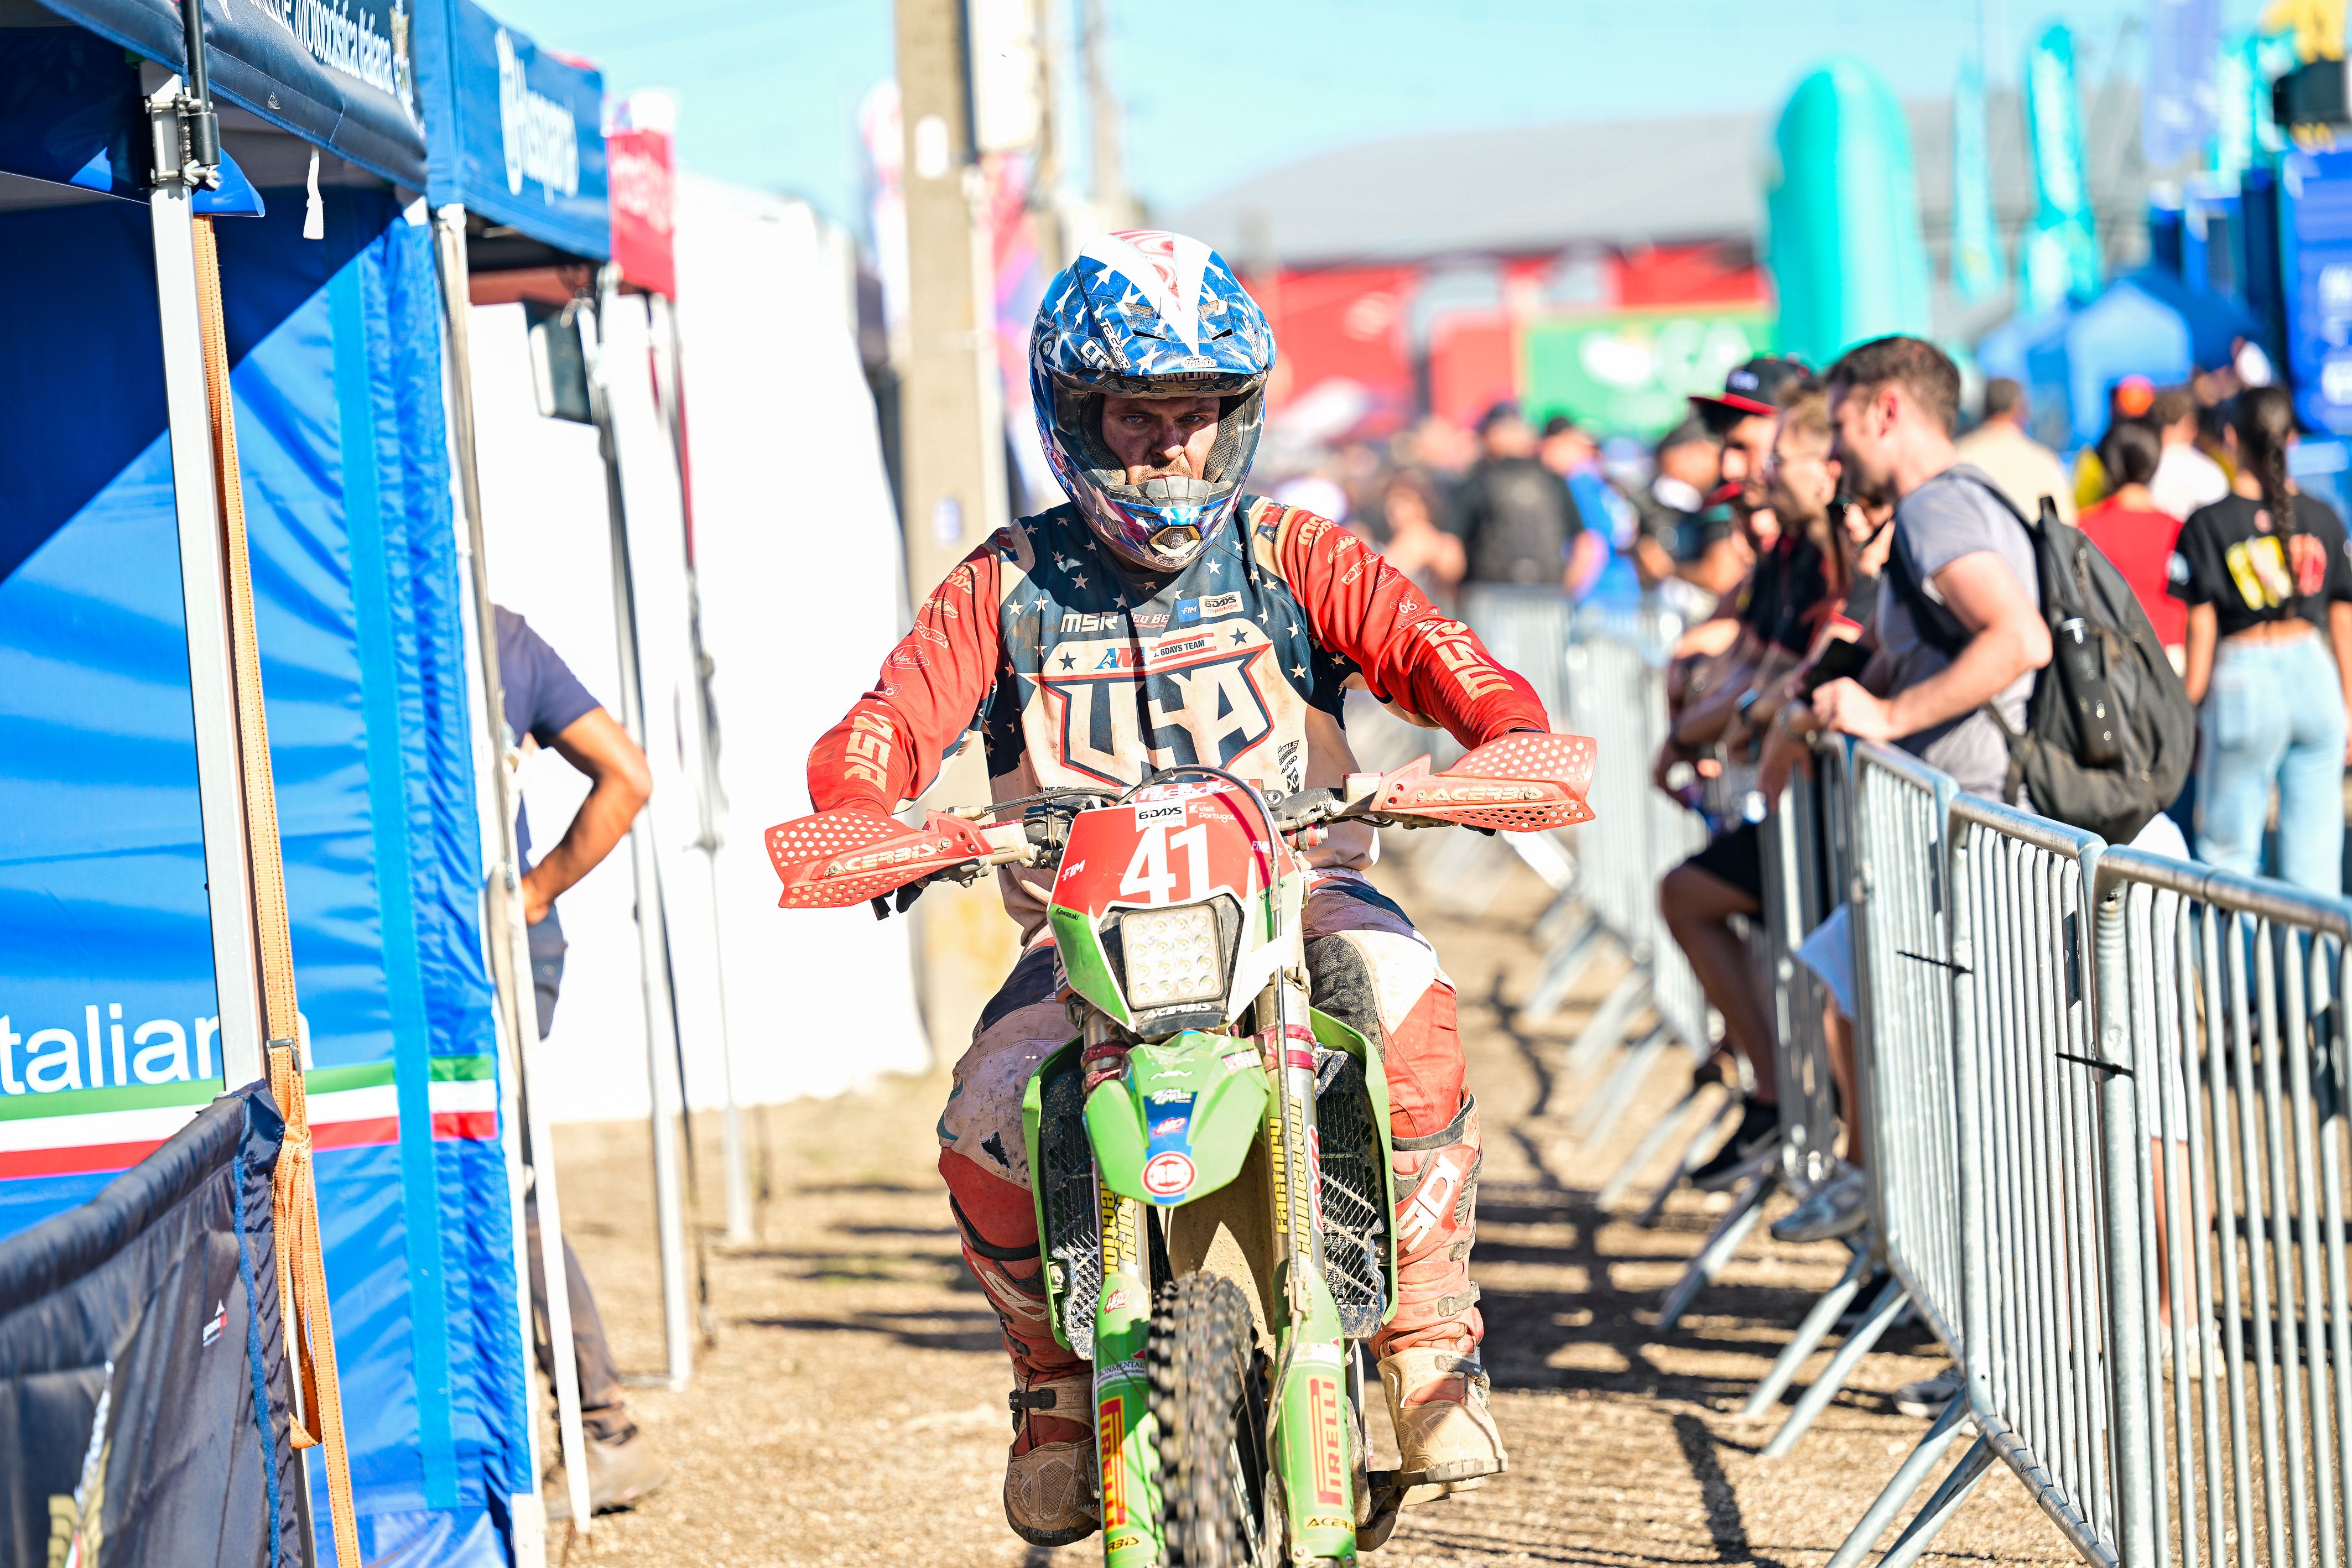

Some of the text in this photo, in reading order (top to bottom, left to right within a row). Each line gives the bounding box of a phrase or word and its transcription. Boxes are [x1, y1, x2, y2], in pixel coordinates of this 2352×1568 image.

[1180, 605, 1198, 614] FIM
[1204, 596, 1236, 608] 6DAYS
[1214, 604, 1238, 614] portugal
[1399, 599, 1417, 614] 66
[1060, 611, 1118, 634] MSR
[1161, 644, 1183, 656] 6DAYS
[1184, 639, 1205, 650] TEAM
[1054, 658, 1269, 782] USA
[1427, 786, 1544, 801] ACERBIS
[1138, 806, 1183, 820] 6DAYS
[1199, 811, 1237, 823] Portugal
[823, 843, 937, 877] ACERBIS
[1119, 823, 1210, 905] 41
[1061, 859, 1086, 882] FIM
[1055, 907, 1080, 921] Kawasaki
[1141, 1003, 1213, 1020] ACERBIS
[1269, 1117, 1288, 1234] Factory
[1117, 1194, 1137, 1265] tory
[1310, 1378, 1343, 1506] PIRELLI
[1100, 1397, 1126, 1528] PIRELLI
[1307, 1518, 1355, 1533] ACERB
[1106, 1536, 1139, 1554] RBIS
